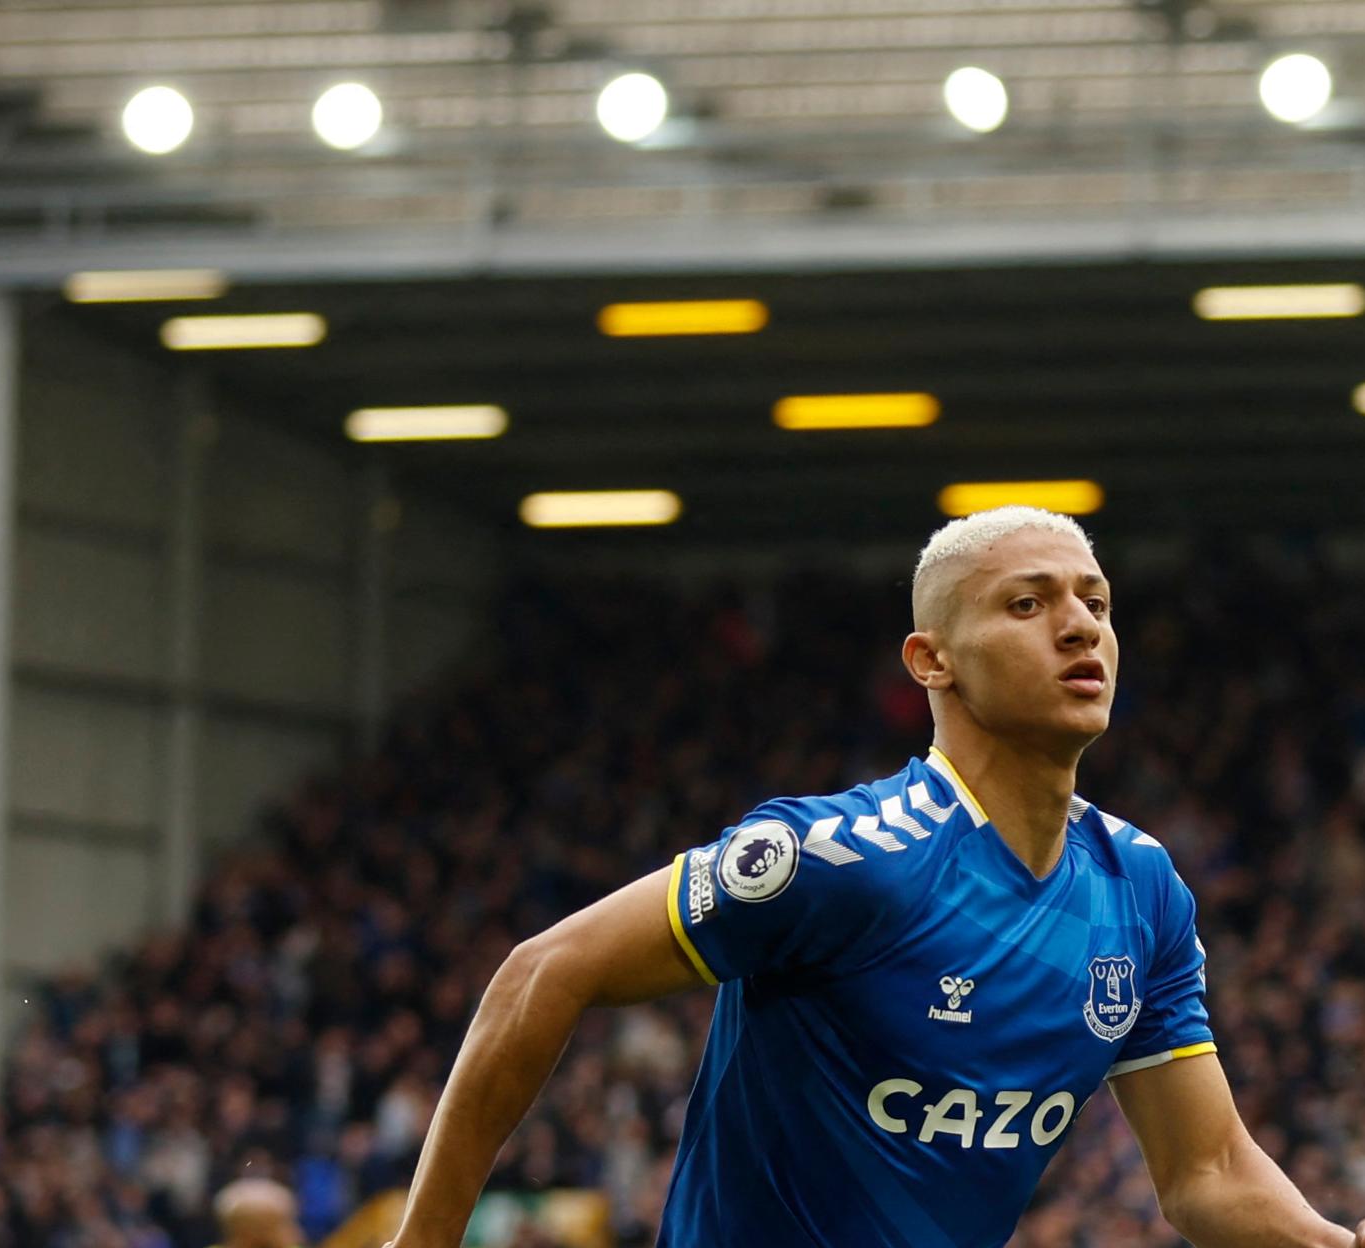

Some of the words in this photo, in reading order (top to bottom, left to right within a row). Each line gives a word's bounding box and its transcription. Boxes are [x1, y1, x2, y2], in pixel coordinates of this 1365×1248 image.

[928, 1005, 972, 1023] hummel
[1098, 1003, 1128, 1014] Everton
[867, 1078, 1091, 1148] CAZO
